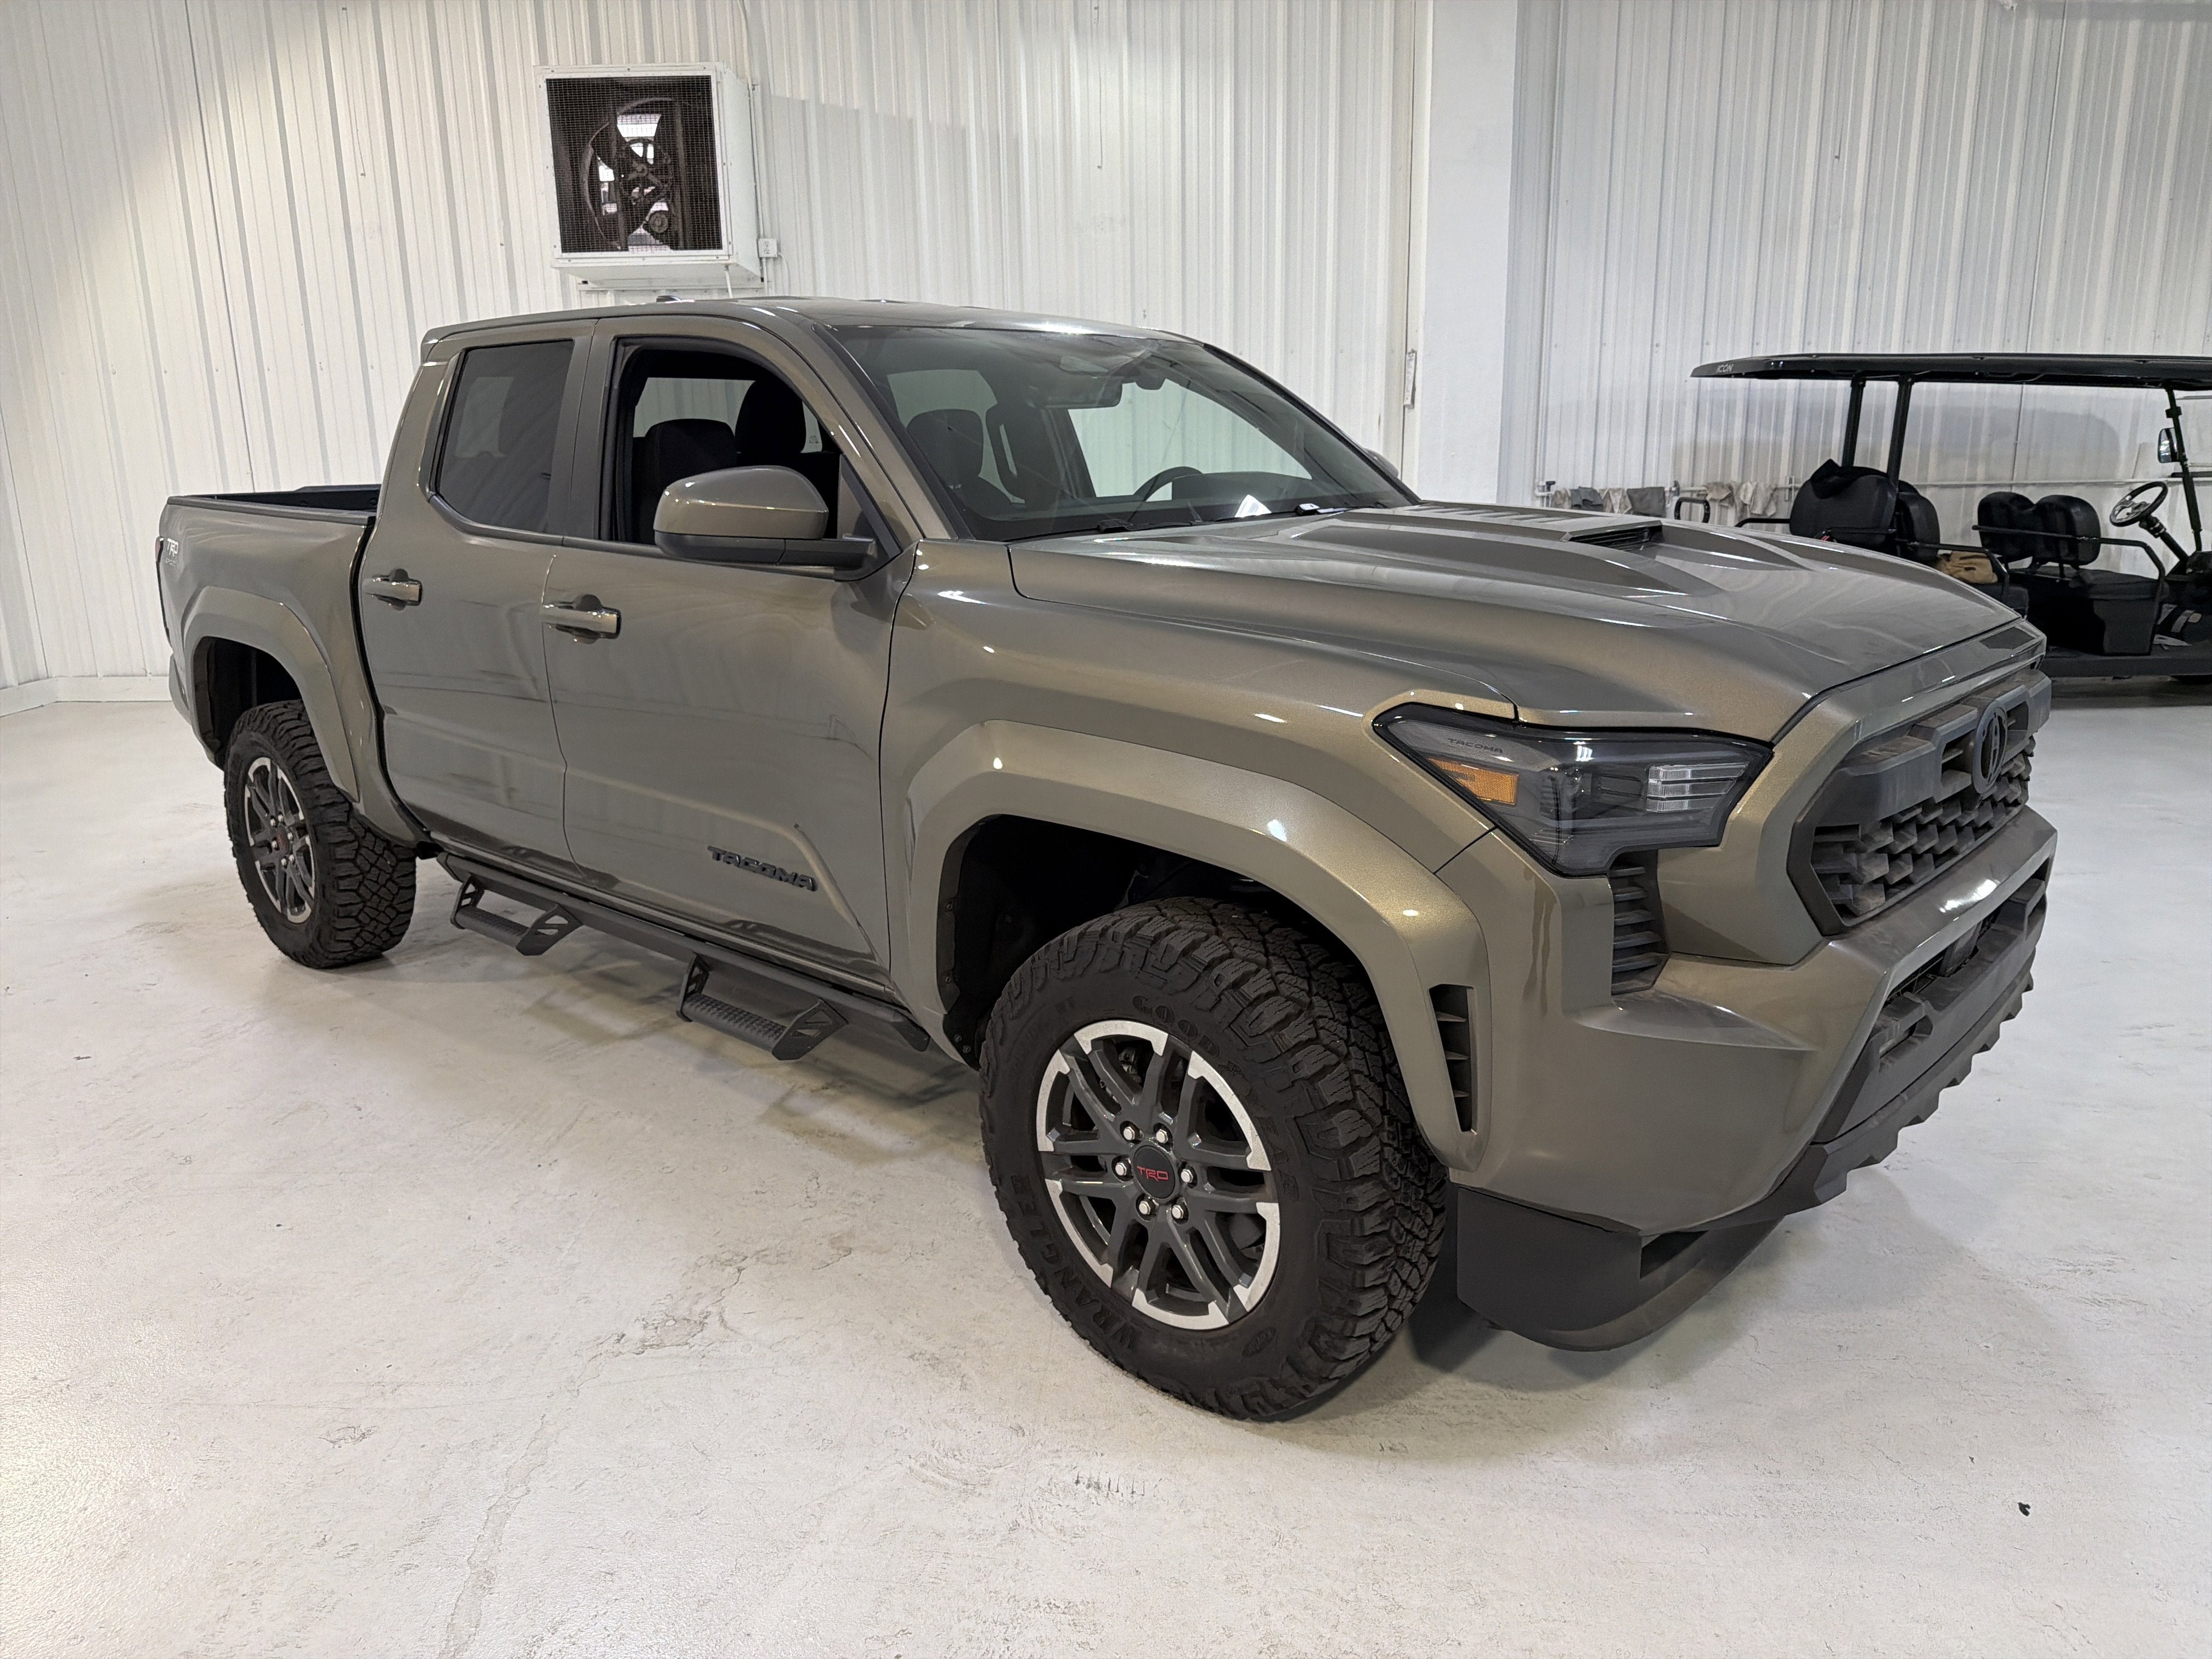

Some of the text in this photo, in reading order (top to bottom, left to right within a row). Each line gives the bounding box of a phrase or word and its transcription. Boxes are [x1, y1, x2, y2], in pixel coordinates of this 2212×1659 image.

[1716, 363, 1734, 374] ICON
[167, 538, 179, 557] TRD
[1447, 738, 1503, 753] TACOMA
[707, 845, 819, 891] TACOMA
[1136, 1165, 1169, 1182] TRD
